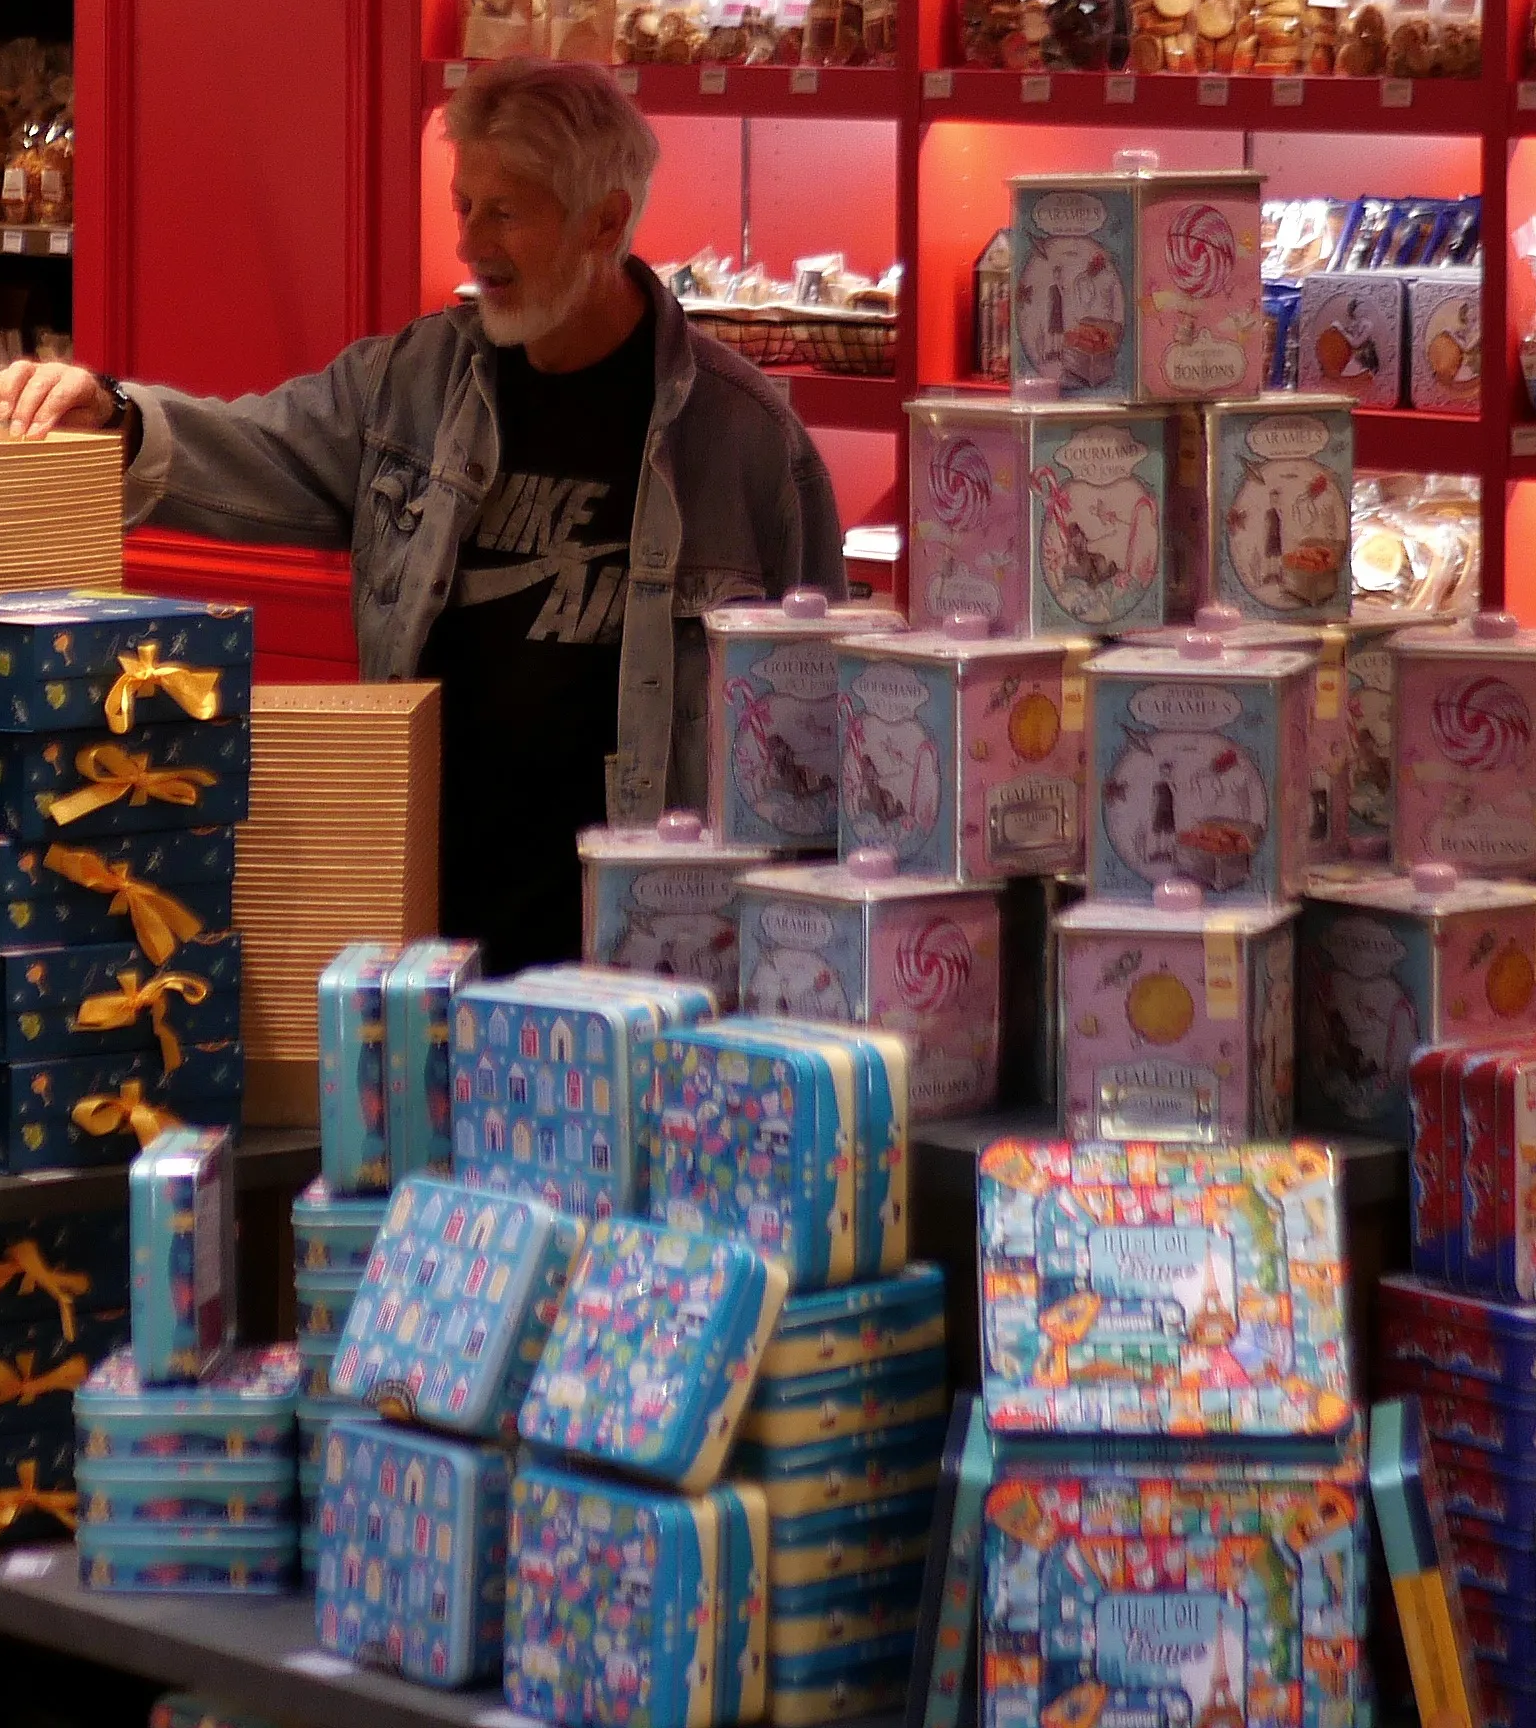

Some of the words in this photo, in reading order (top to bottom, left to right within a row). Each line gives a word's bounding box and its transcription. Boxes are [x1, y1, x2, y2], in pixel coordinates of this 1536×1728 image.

[1174, 363, 1235, 380] BONBONS
[1063, 444, 1140, 461] GOURMAND
[467, 472, 611, 557] NIKE
[764, 661, 835, 675] GOURMA
[909, 1079, 970, 1098] ONBONS
